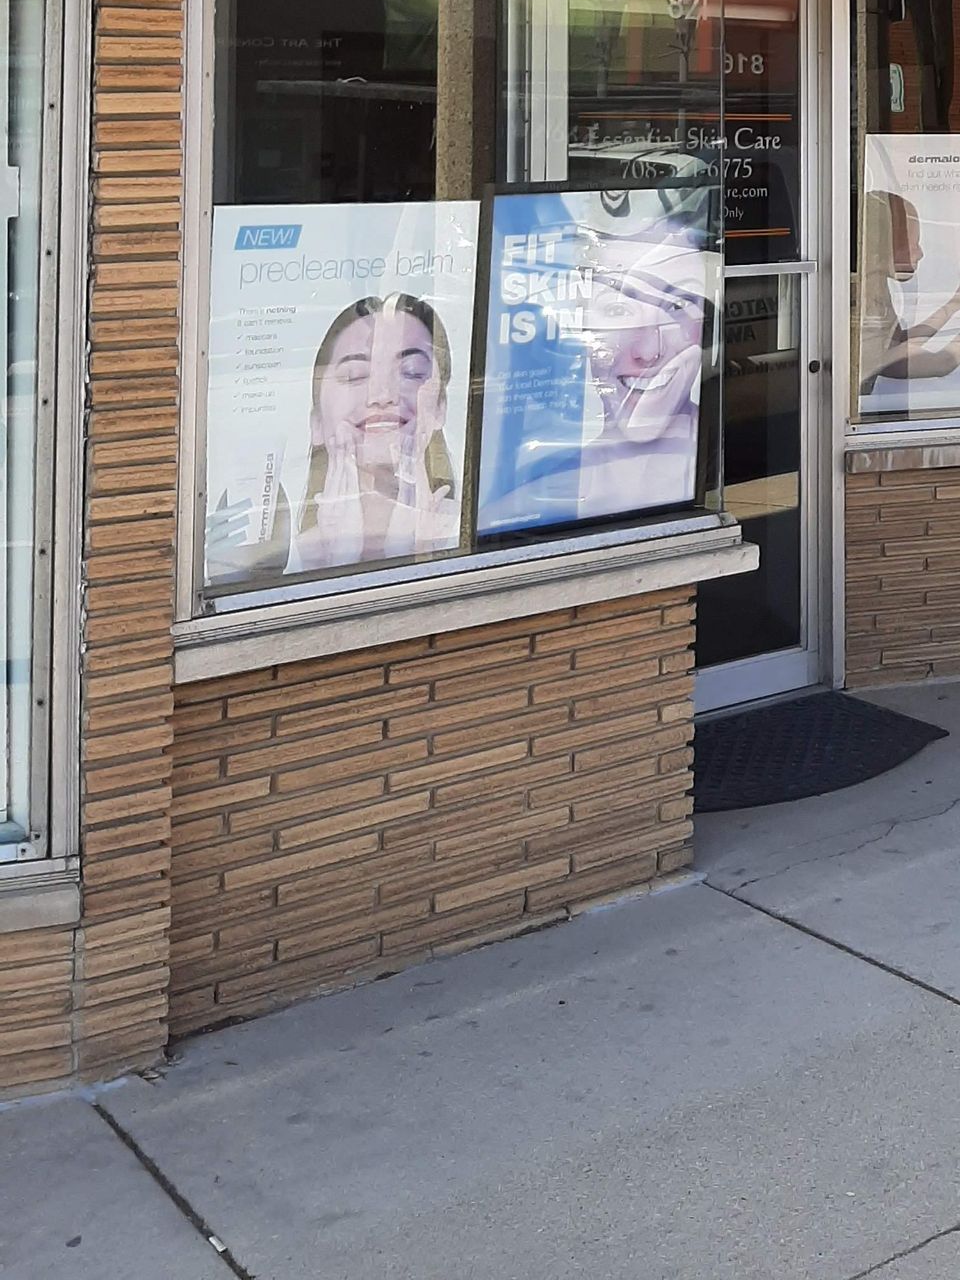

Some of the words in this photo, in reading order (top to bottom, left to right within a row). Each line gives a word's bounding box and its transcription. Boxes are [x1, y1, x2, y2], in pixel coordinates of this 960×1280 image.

[686, 126, 728, 150] Skin
[734, 126, 782, 150] Care
[620, 157, 753, 180] 708-1-6775
[242, 227, 295, 247] NEW!
[503, 232, 563, 266] FIT
[239, 254, 386, 290] precleanse
[395, 249, 454, 277] balm
[502, 268, 593, 306] SKIN
[499, 310, 537, 345] IS
